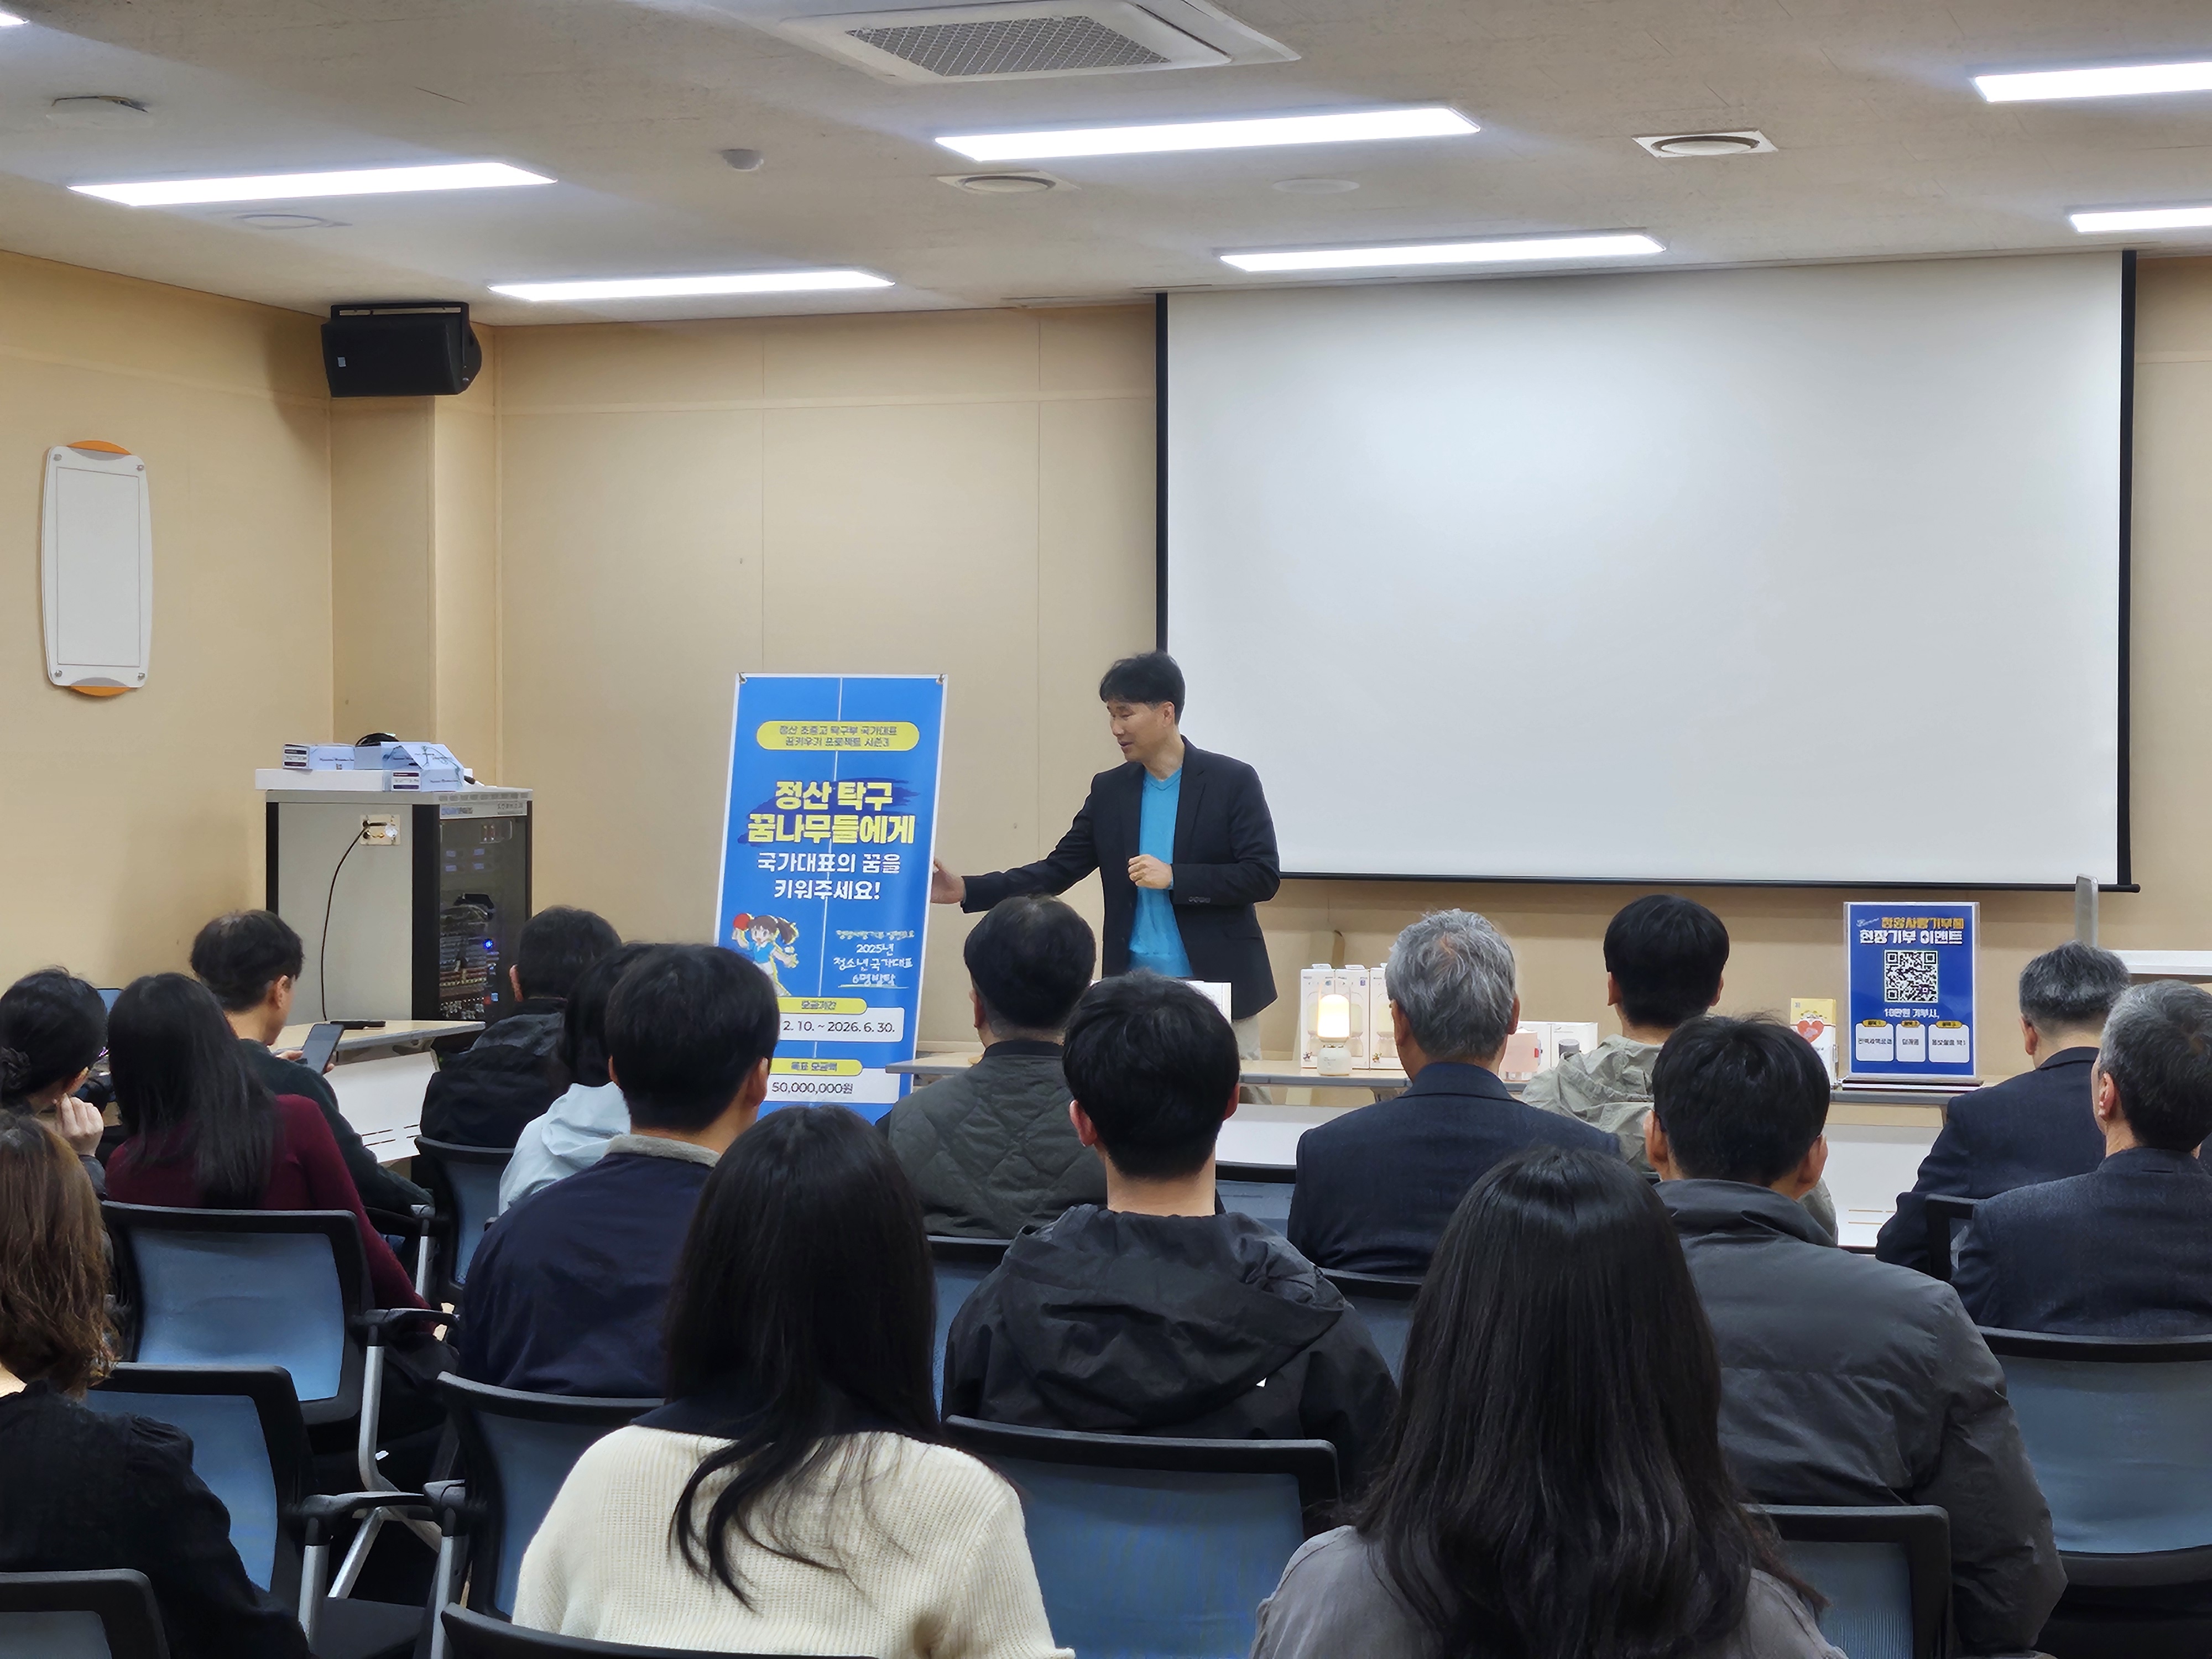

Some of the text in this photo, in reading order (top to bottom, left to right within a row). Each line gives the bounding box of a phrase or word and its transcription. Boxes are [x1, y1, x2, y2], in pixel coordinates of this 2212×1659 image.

[775, 781, 893, 811] 정산 탁구
[748, 814, 915, 844] 꿈나무들에게
[757, 852, 901, 874] 국가대표의 꿈을
[774, 880, 880, 900] 키워주세요!
[1860, 930, 1963, 944] 현장기부 이벤트
[856, 943, 894, 956] 2025년
[772, 1082, 853, 1094] 50,000,000원
